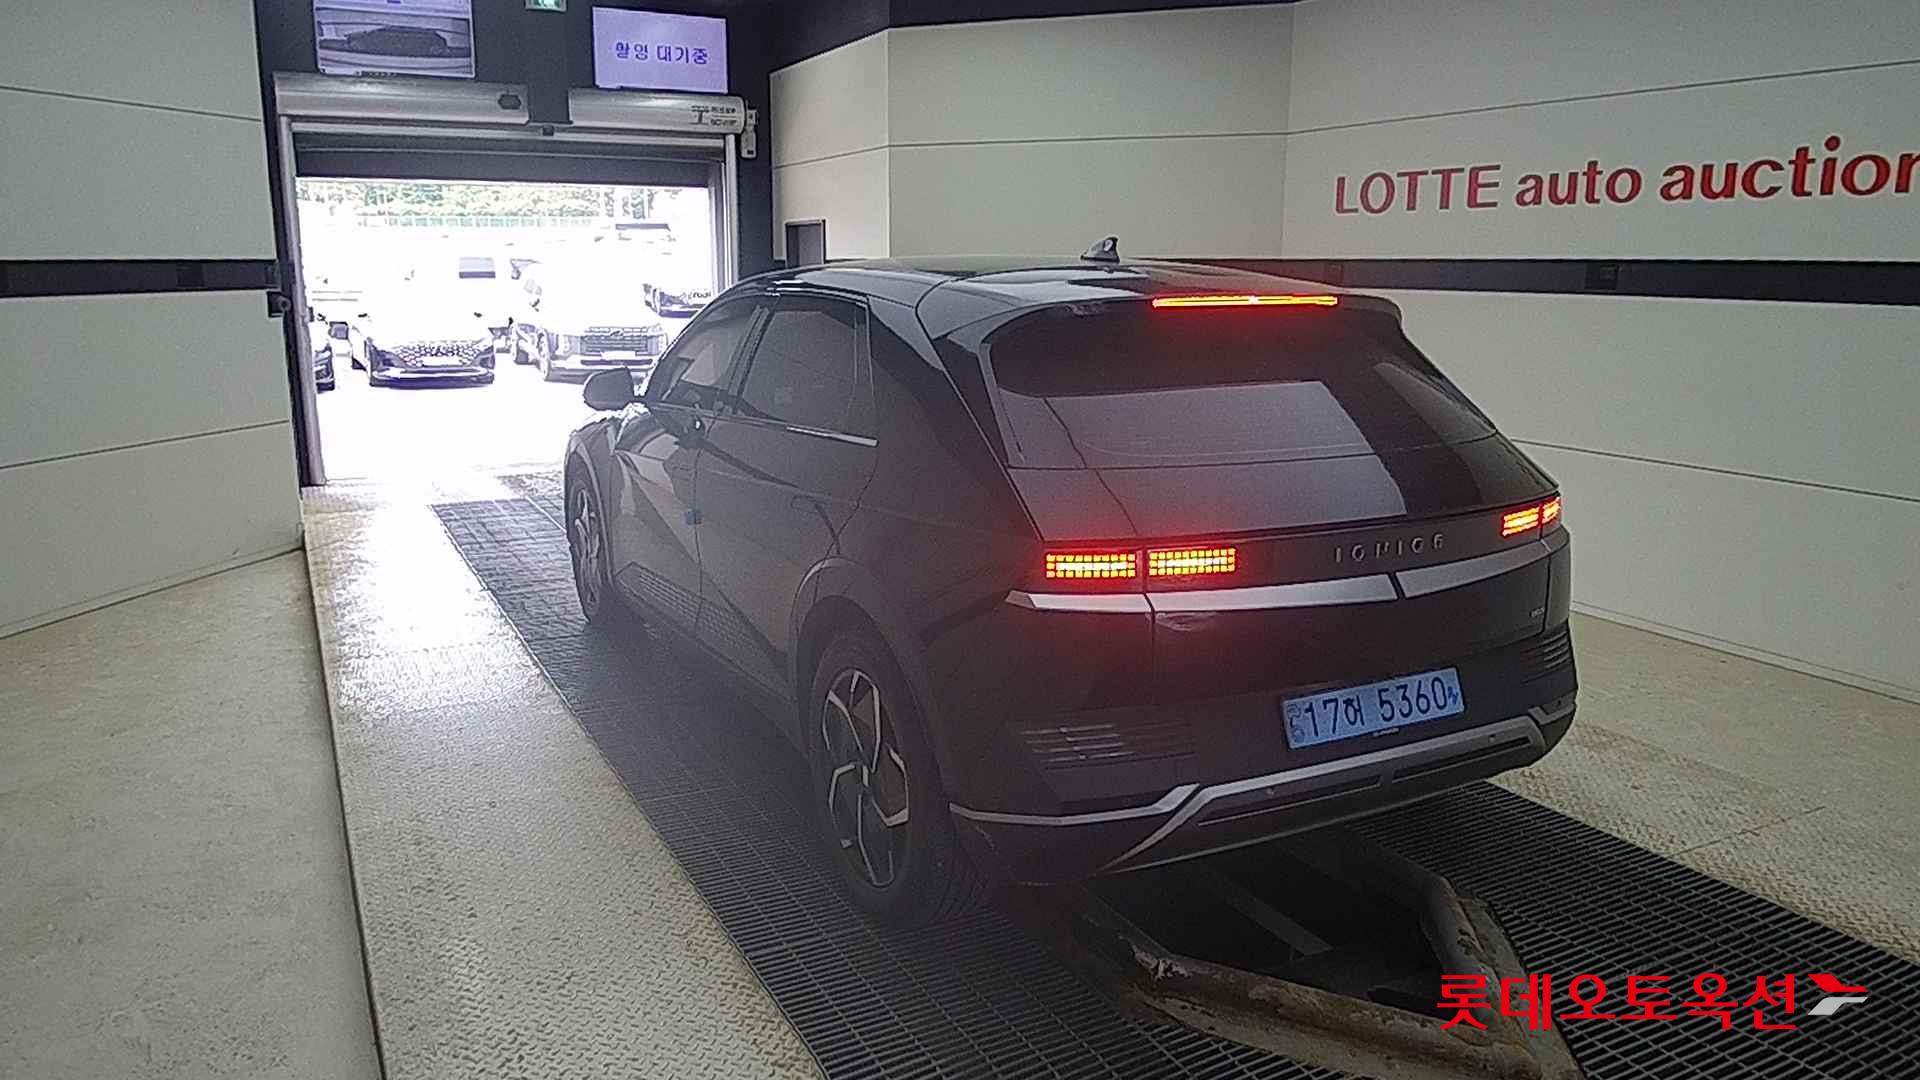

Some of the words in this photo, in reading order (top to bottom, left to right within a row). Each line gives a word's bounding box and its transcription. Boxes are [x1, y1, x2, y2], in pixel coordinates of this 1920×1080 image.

[656, 44, 709, 65] 대기중
[1336, 164, 1501, 214] LOTTE
[1515, 160, 1642, 207] auto
[1376, 676, 1448, 723] 5360
